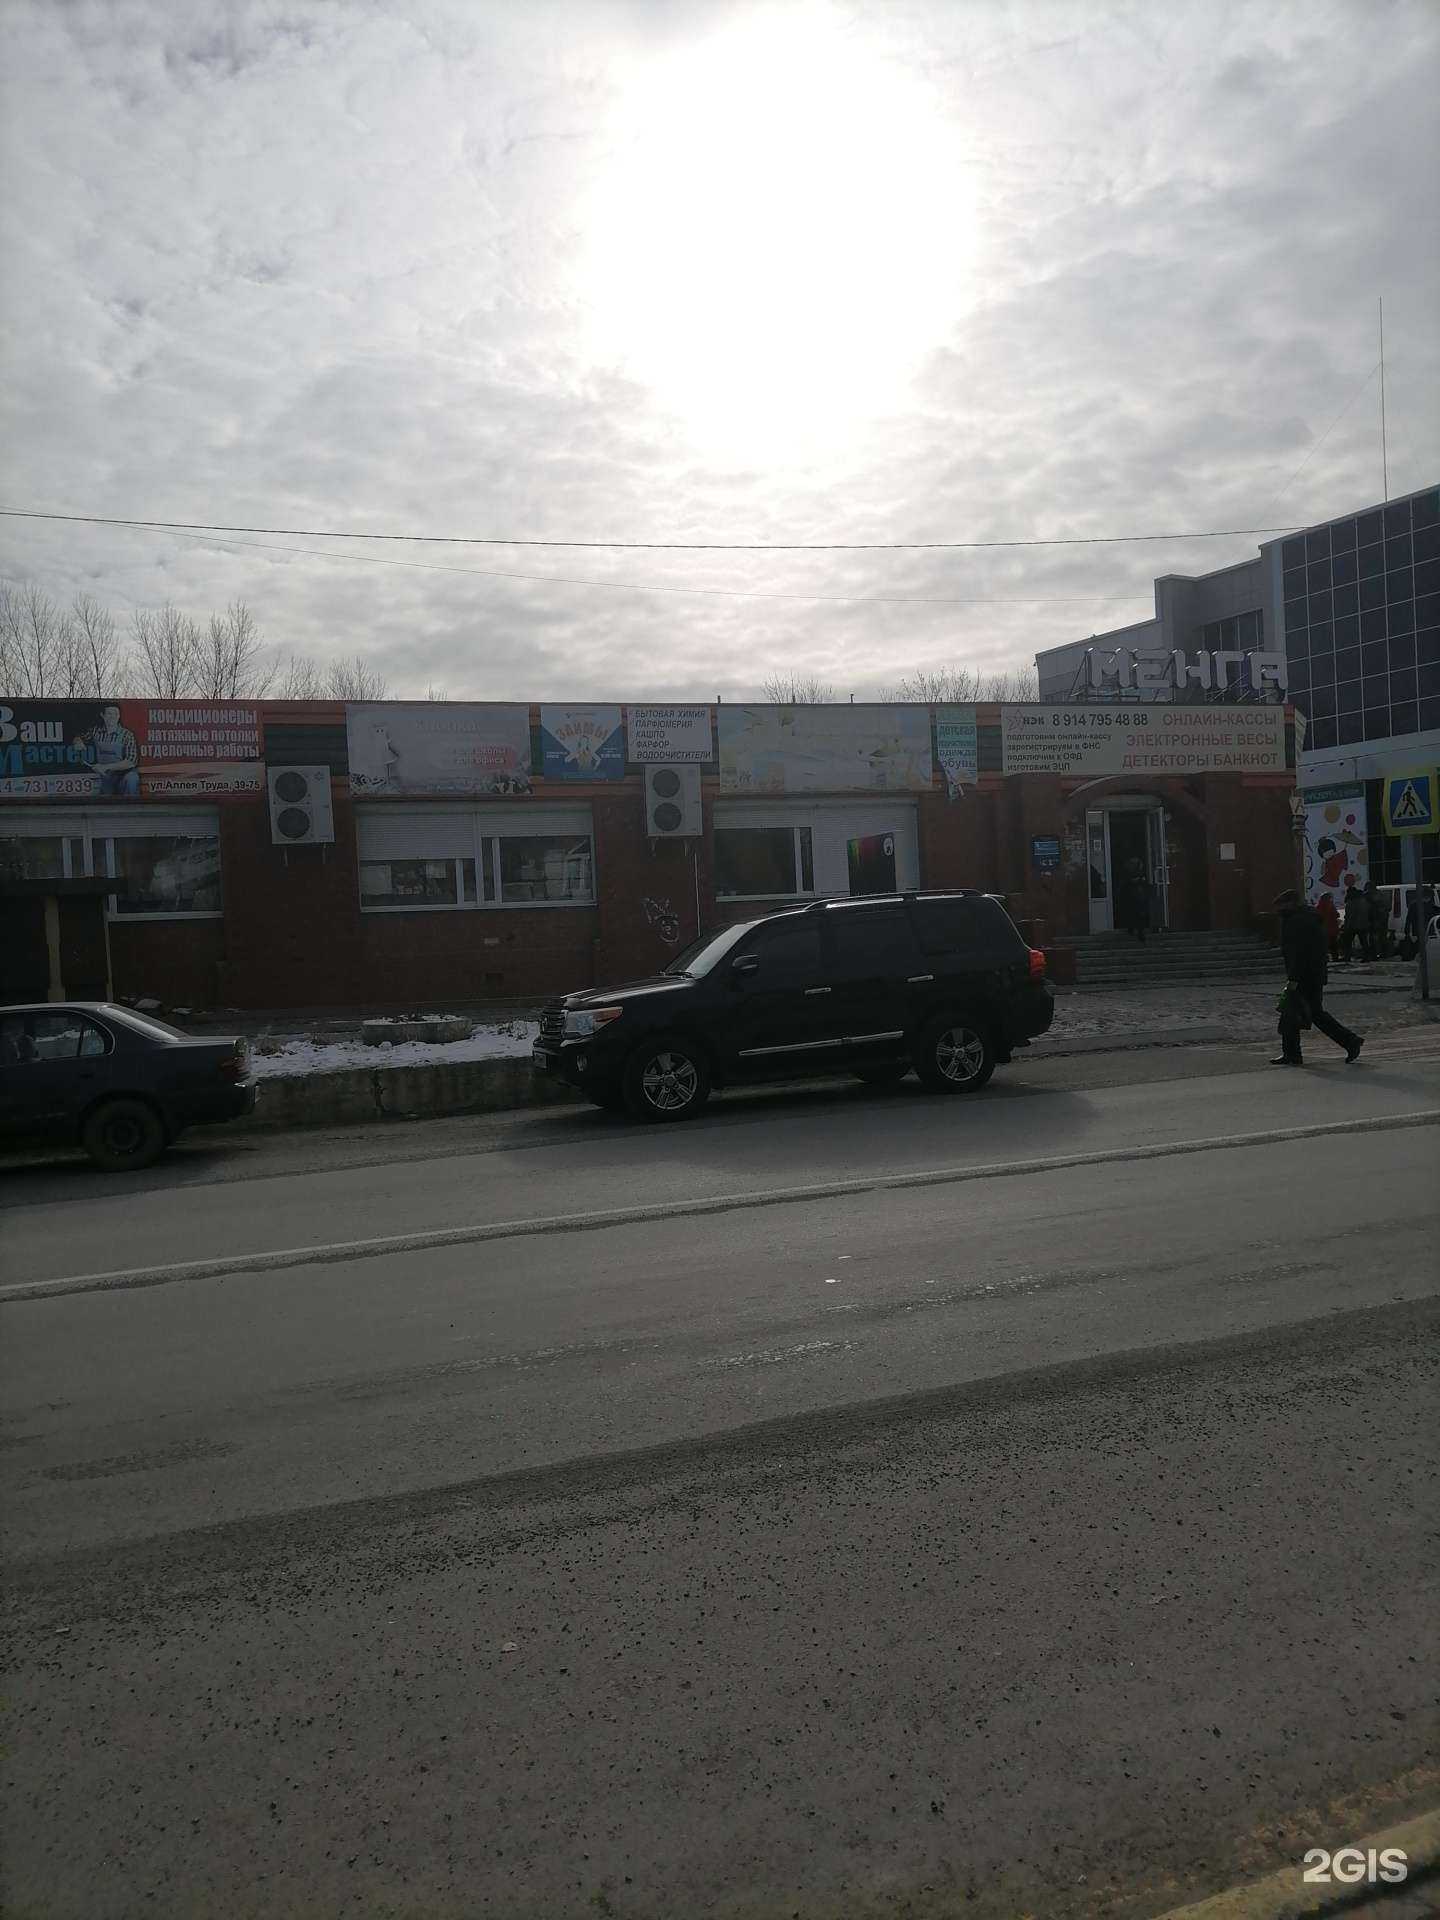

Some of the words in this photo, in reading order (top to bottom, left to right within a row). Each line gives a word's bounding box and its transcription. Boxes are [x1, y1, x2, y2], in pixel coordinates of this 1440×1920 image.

[1089, 649, 1289, 690] МЕНГА
[635, 710, 675, 718] БЫТОВАЯ
[677, 710, 706, 718] ХИМИЯ
[1162, 712, 1277, 726] ОНЛАЙН-КАССЫ
[1052, 714, 1060, 726] 8
[1063, 714, 1087, 726] 914
[1089, 714, 1112, 726] 795
[1115, 714, 1130, 726] 48
[1133, 714, 1149, 726] 88
[635, 730, 665, 738] КАШПО
[636, 740, 670, 748] ФАРФОР
[1126, 734, 1233, 747] ЭЛЕКТРОННЫЕ
[1237, 733, 1277, 746] ВЕСЫ
[140, 744, 215, 758] отделочные
[216, 743, 260, 758] работы
[1082, 742, 1101, 750] ФНС
[636, 751, 712, 760] ВОДООЧИСТИТЕЛИ
[1007, 754, 1055, 762] подключим
[1063, 752, 1083, 761] ОФД
[1122, 753, 1209, 769] ДЕТЕКТОРЫ
[1213, 752, 1278, 767] БАНКНОТ
[1052, 762, 1071, 772] ЭЦП
[55, 781, 93, 793] 2839
